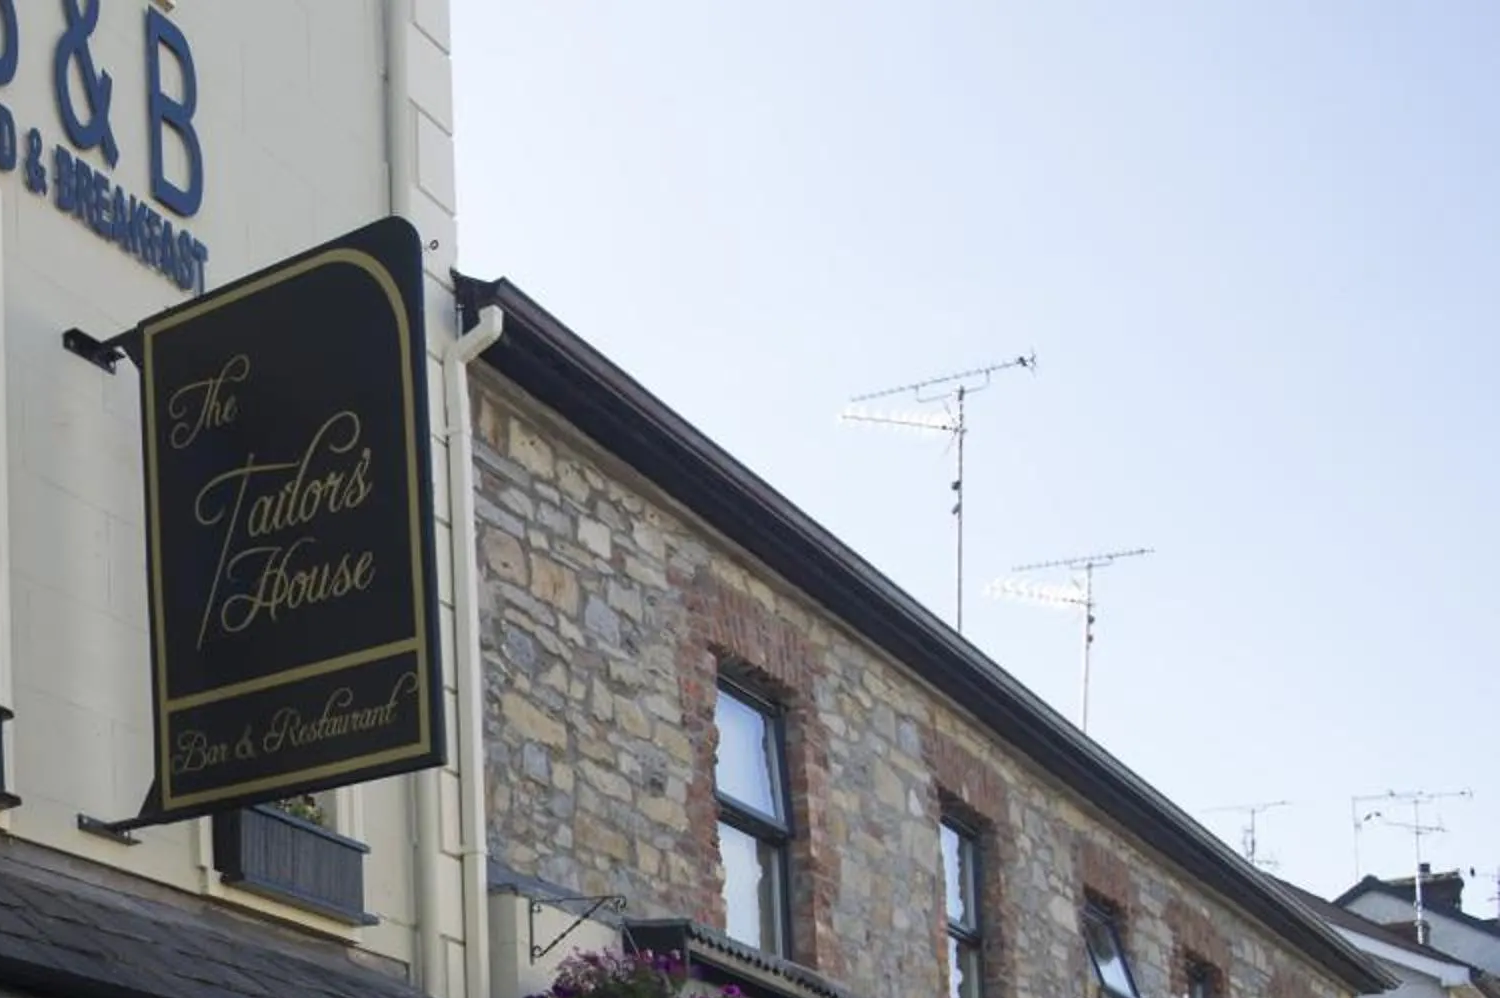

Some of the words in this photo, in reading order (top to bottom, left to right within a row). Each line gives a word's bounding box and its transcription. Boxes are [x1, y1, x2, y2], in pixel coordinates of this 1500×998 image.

[146, 5, 205, 218] B
[24, 127, 48, 196] &
[53, 143, 209, 296] BREAKFAST
[169, 354, 250, 449] The
[221, 537, 376, 632] House
[171, 729, 228, 774] Bar
[236, 726, 256, 760] &
[263, 671, 420, 753] Restaurant
